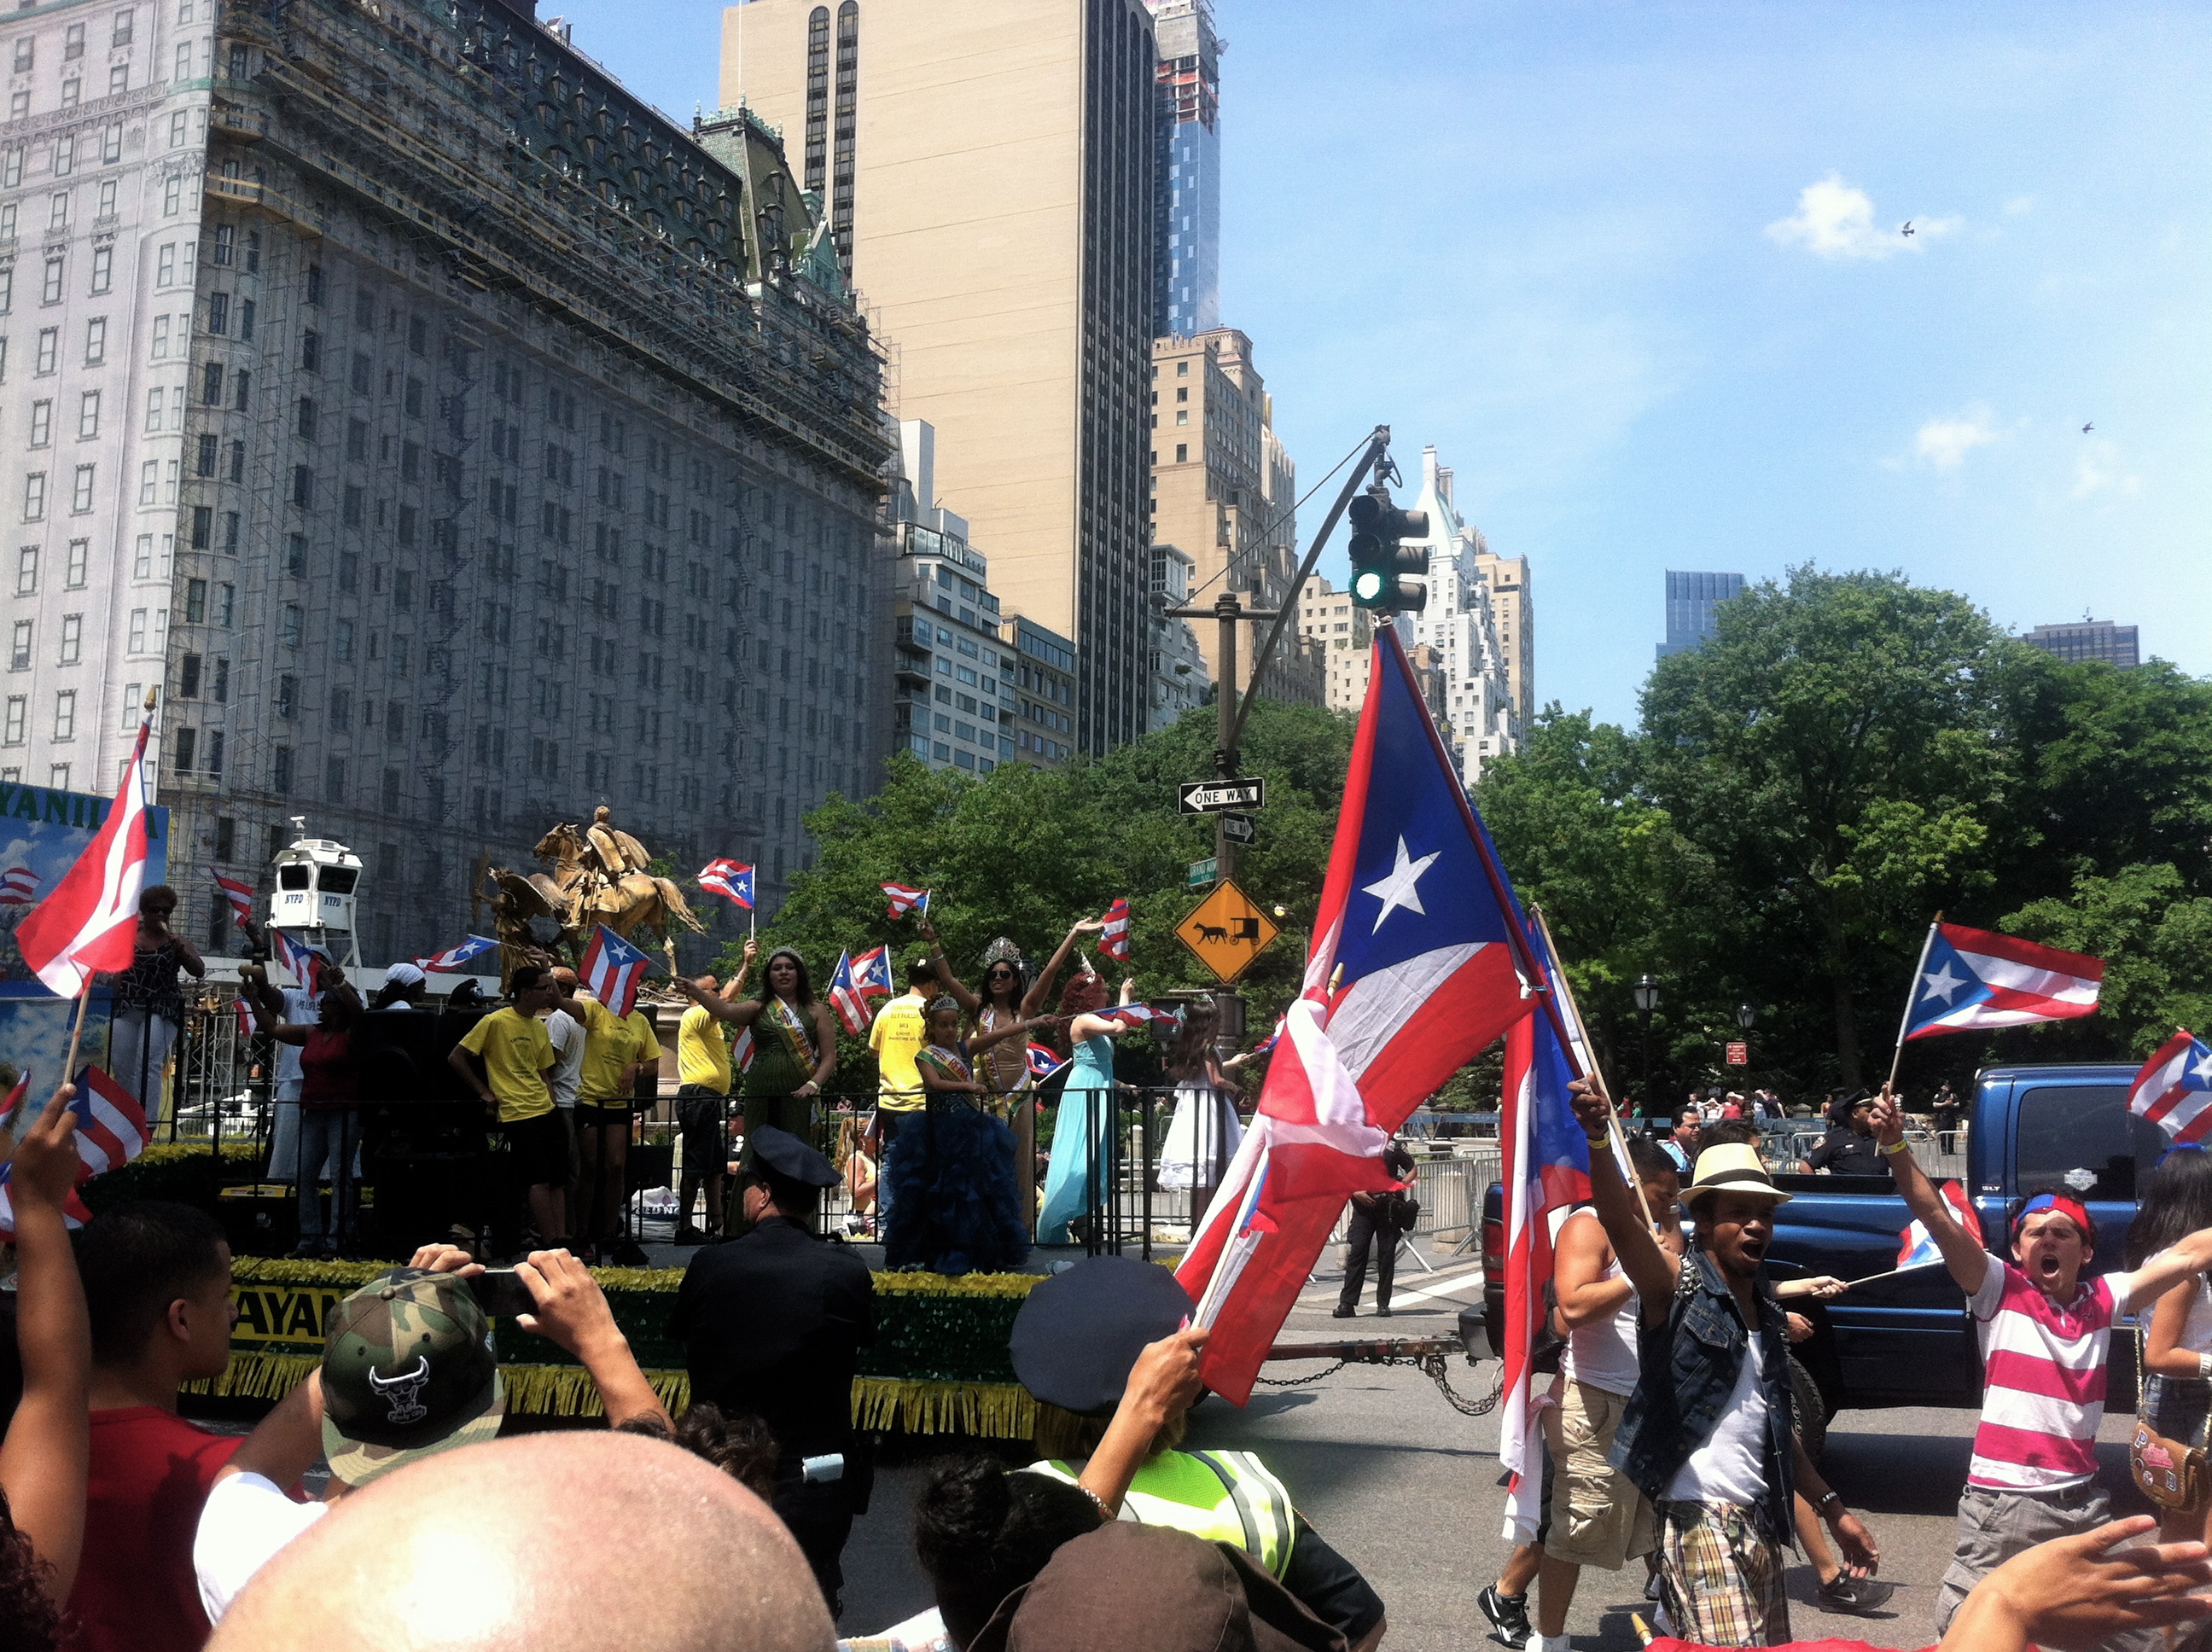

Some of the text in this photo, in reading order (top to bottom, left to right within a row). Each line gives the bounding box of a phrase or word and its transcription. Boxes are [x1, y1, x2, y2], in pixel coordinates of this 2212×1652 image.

[1195, 788, 1252, 804] ONE WAY
[1239, 822, 1249, 835] WAY
[285, 893, 304, 904] NYPD
[324, 895, 341, 907] NYPD
